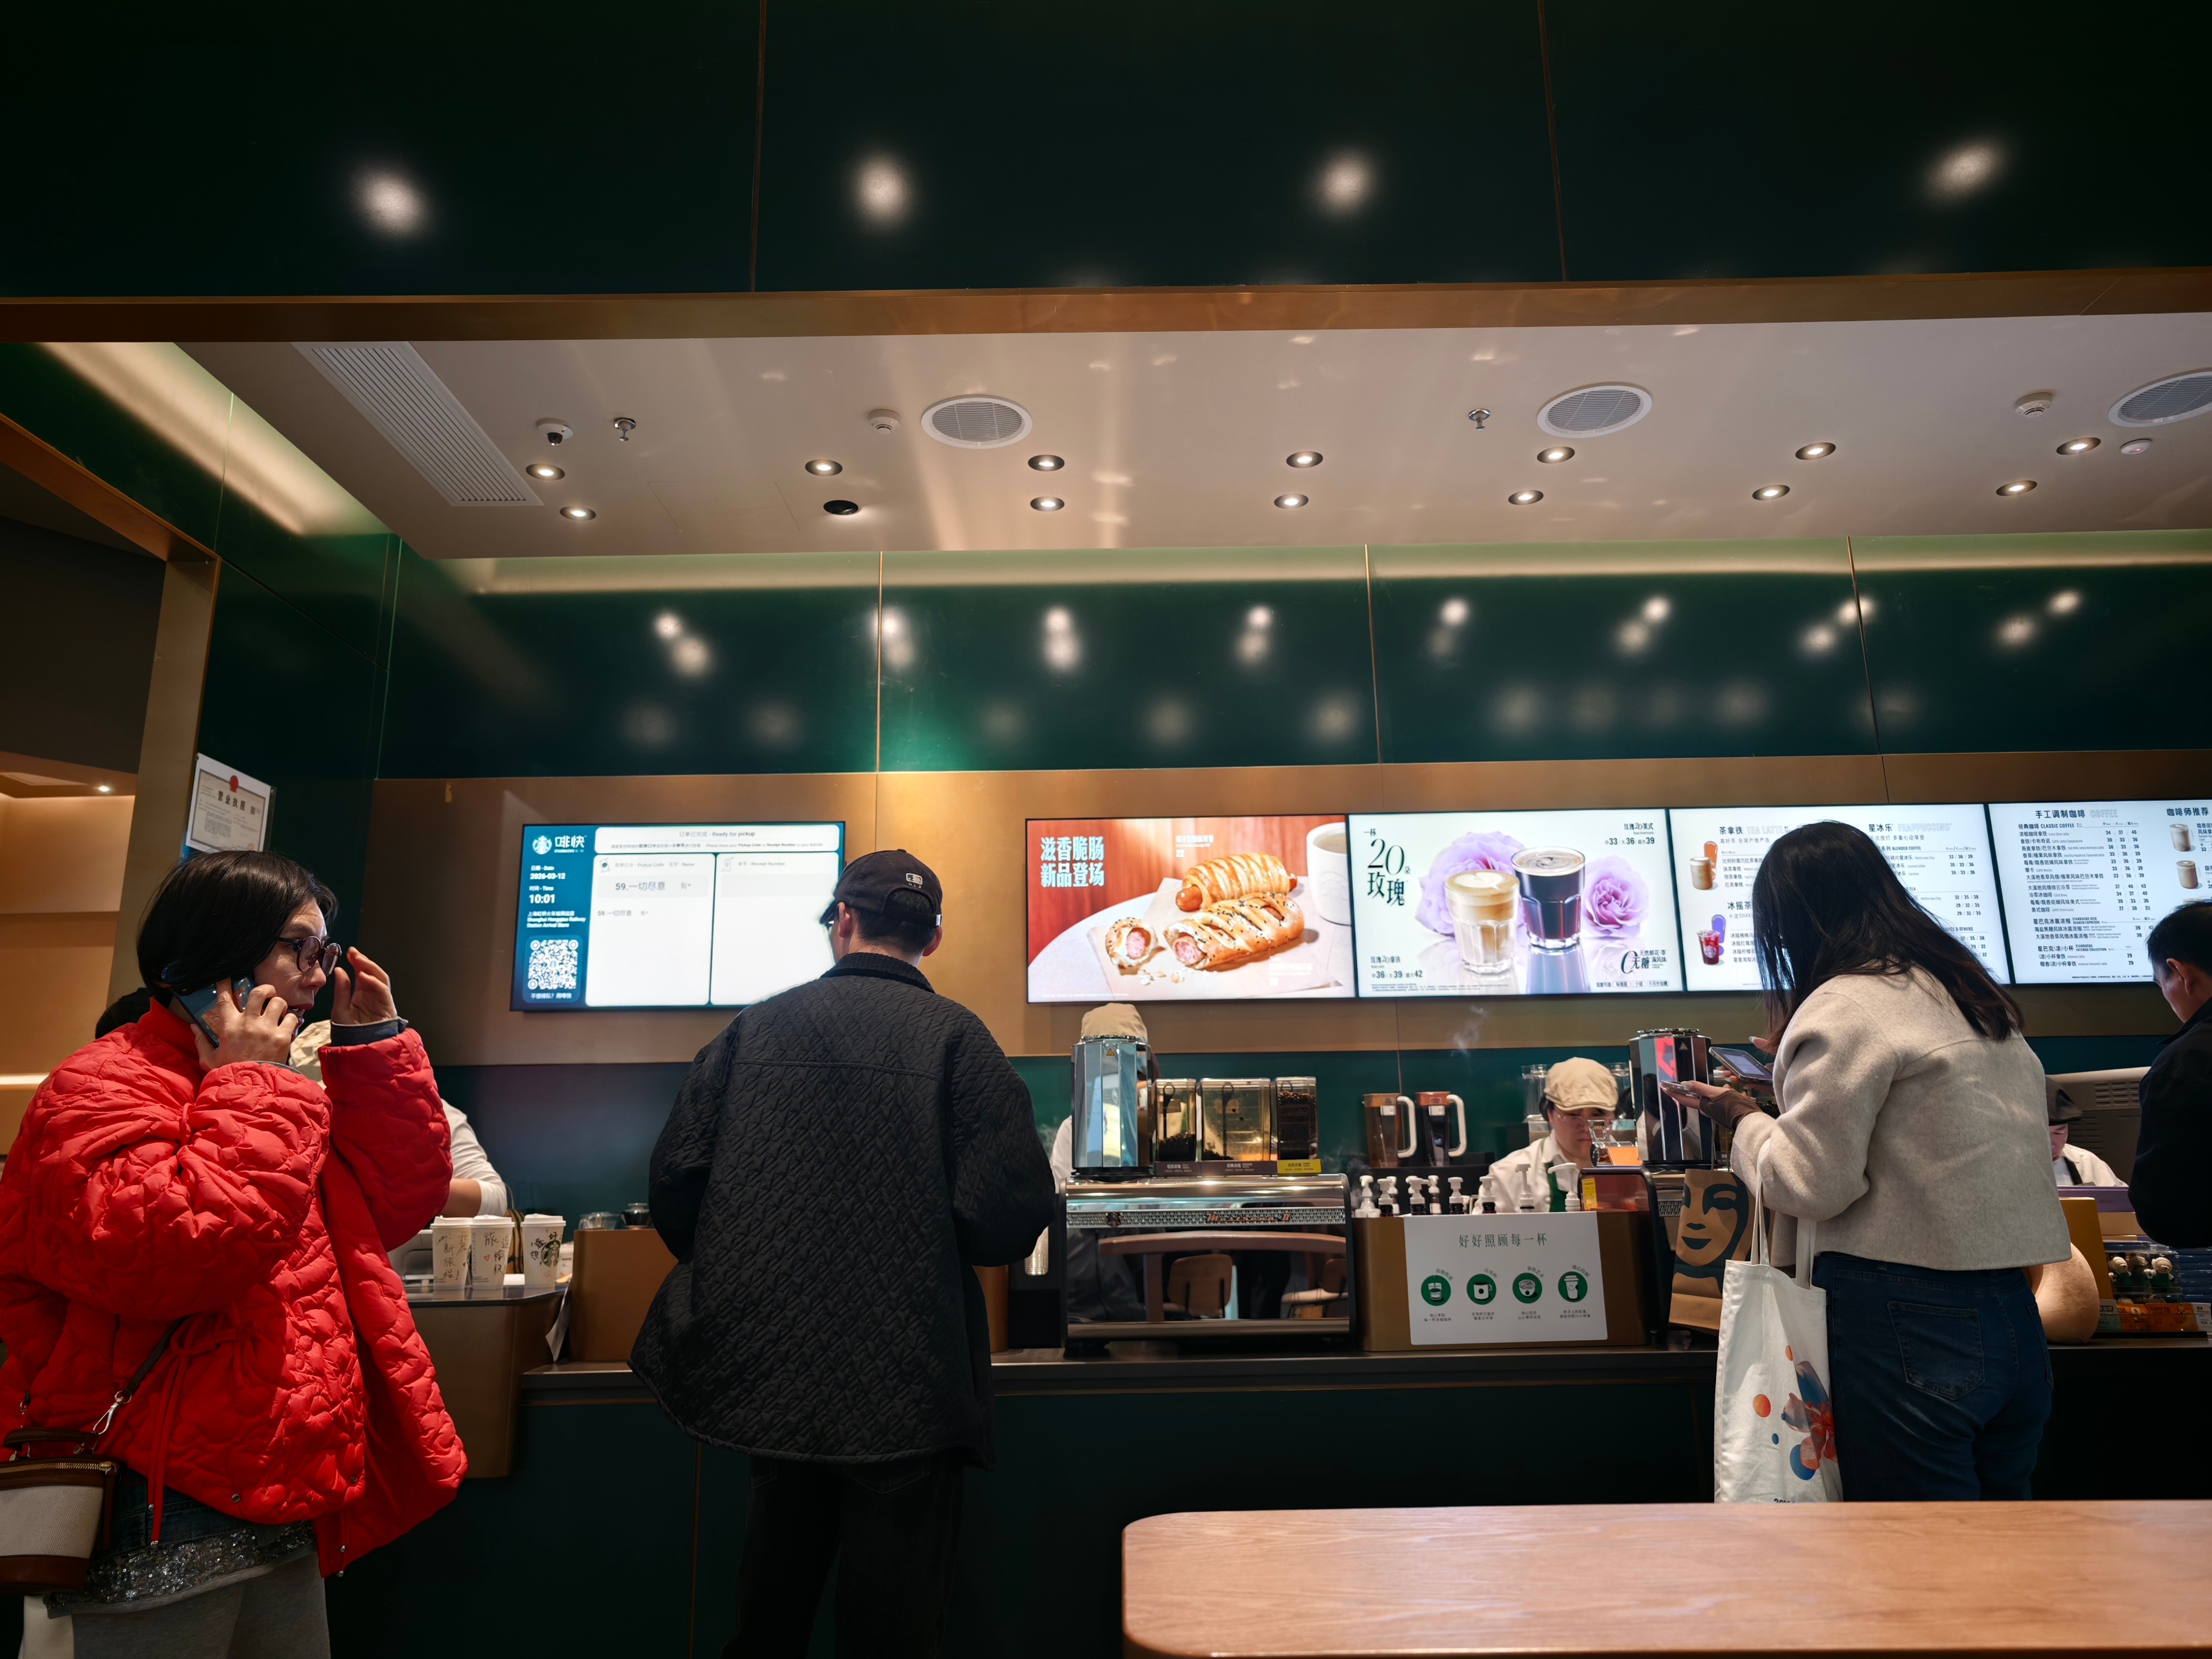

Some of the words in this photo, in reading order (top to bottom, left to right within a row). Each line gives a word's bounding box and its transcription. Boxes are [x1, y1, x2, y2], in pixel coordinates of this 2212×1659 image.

[218, 791, 245, 811] 营业执照
[2035, 810, 2086, 819] 手工调制咖啡
[2089, 810, 2118, 818] COFFEE
[2167, 807, 2209, 817] 咖啡师推荐
[1364, 828, 1377, 837] 一杯
[1719, 826, 1743, 834] 茶拿铁
[1746, 826, 1761, 834] TEA
[1762, 826, 1783, 834] LATTE
[554, 835, 585, 848] 啡快
[1040, 836, 1104, 861] 滋香脆肠
[1367, 838, 1405, 875] 20
[1040, 862, 1104, 888] 新品登场
[1405, 866, 1411, 874] 朵
[616, 881, 666, 892] 59.一切尽意
[1367, 872, 1405, 906] 玫瑰
[529, 894, 555, 903] 10:01
[1728, 901, 1751, 910] 冰摇茶
[1631, 956, 1649, 969] 无糖
[1459, 1232, 1547, 1247] 好好照顾每一杯
